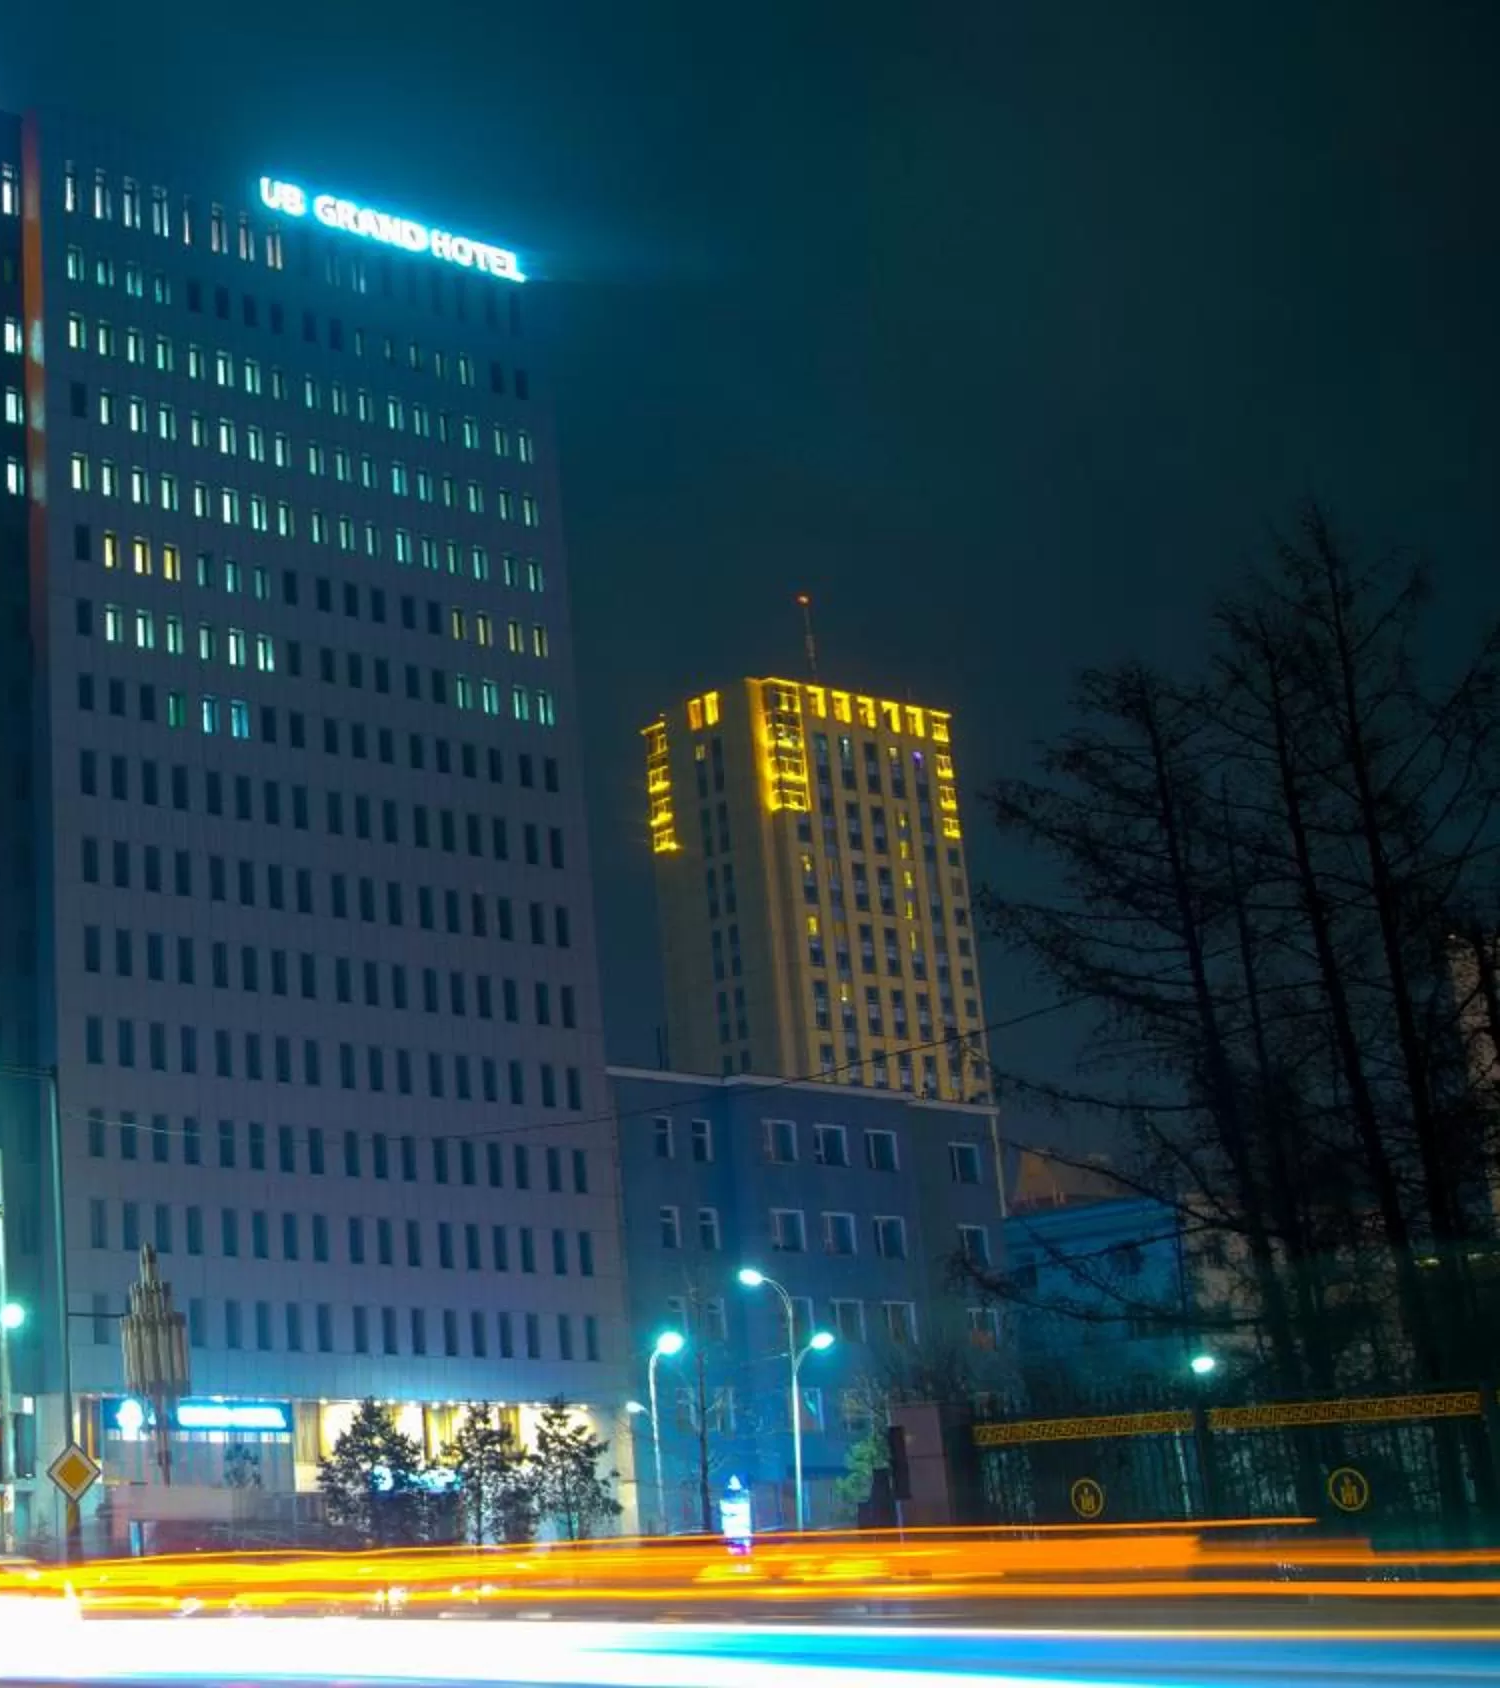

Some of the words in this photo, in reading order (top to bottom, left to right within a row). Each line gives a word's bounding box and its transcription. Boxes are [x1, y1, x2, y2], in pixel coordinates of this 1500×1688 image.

[260, 176, 306, 216] UB
[313, 195, 430, 251] GRAND
[430, 228, 527, 283] HOTEL
